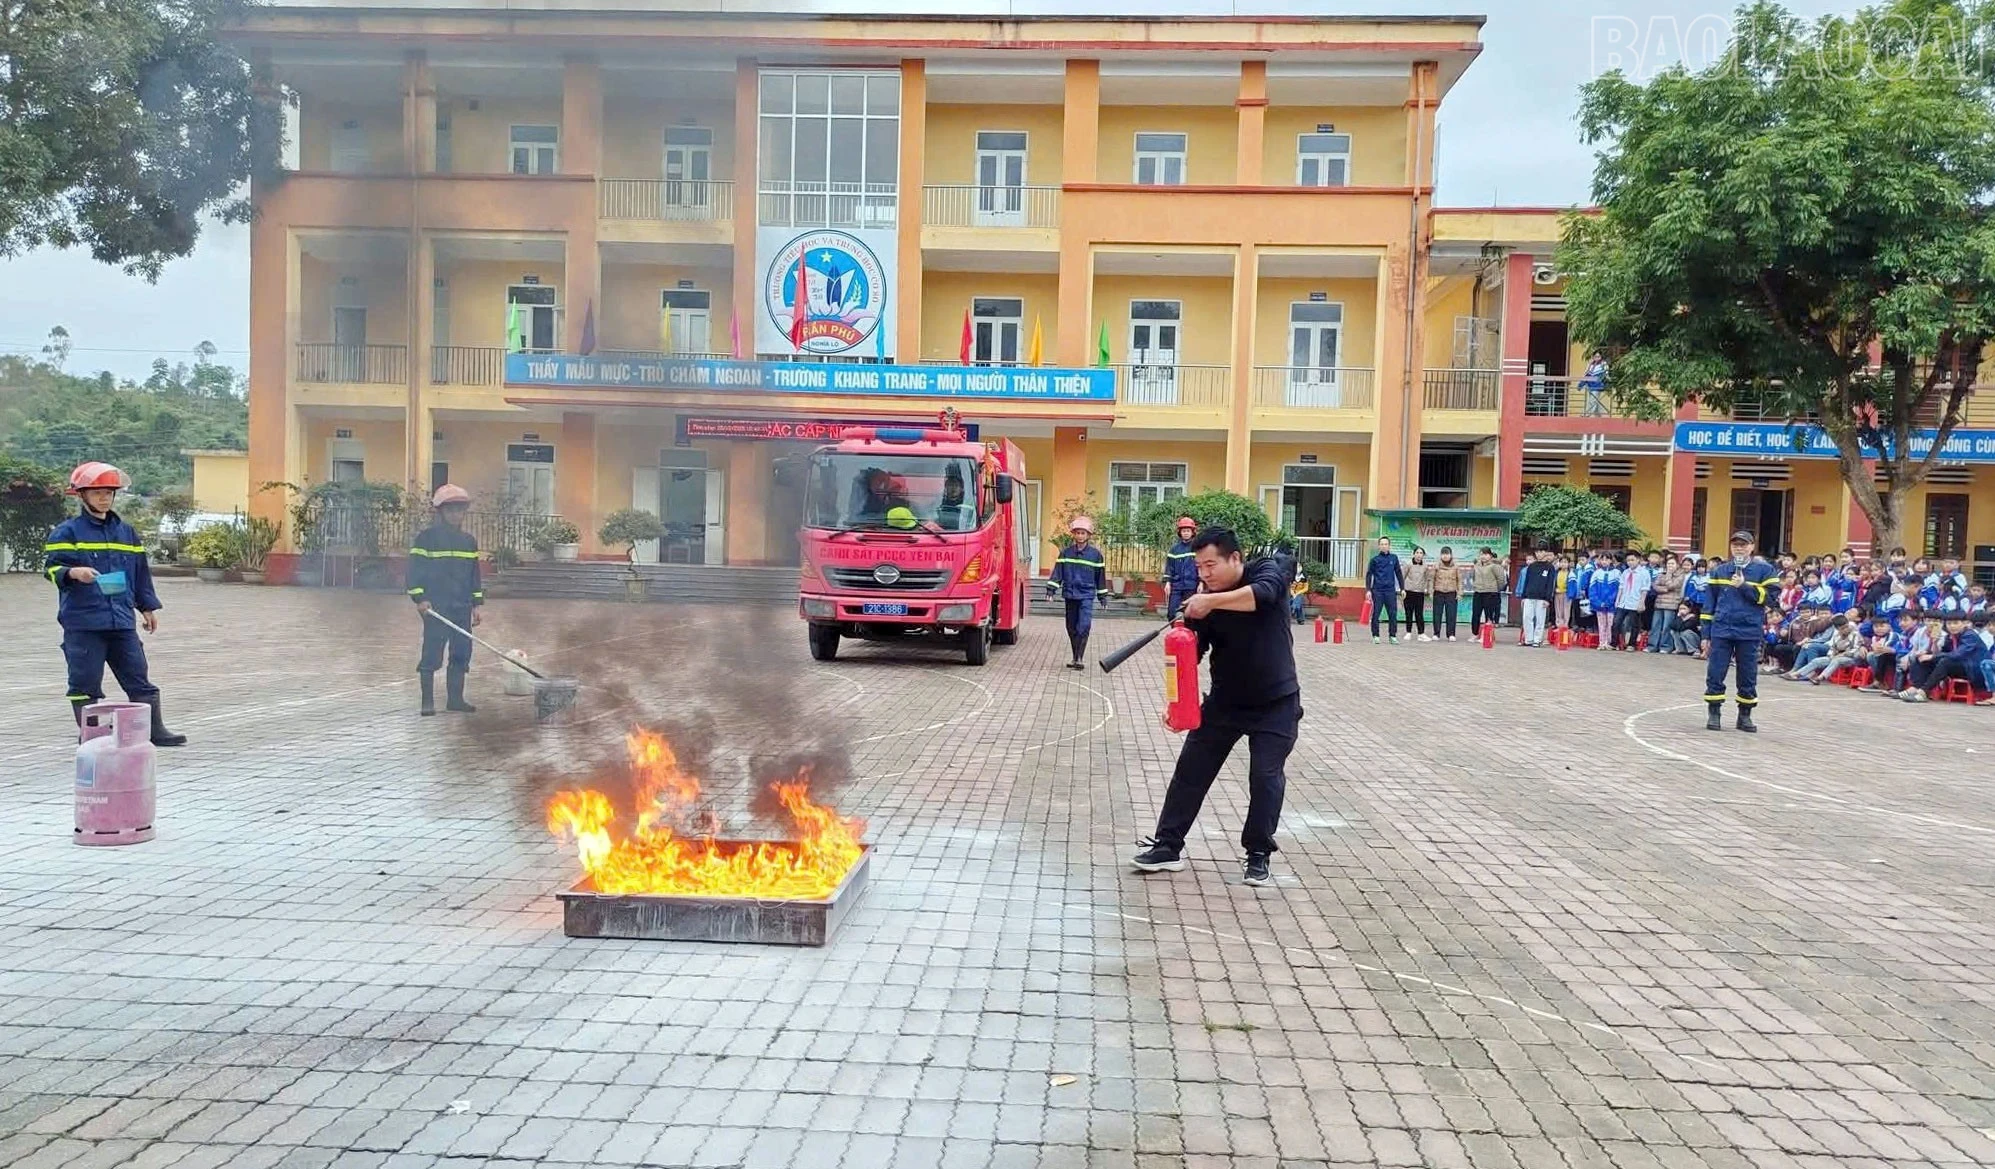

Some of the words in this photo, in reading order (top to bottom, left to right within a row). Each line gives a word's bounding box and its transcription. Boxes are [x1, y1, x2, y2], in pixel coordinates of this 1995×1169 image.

[527, 358, 560, 380] THẦY
[565, 358, 595, 381] MẪU
[601, 361, 631, 384] MỰC
[670, 364, 710, 384] CHĂM
[715, 367, 762, 385] NGOAN
[773, 366, 827, 388] TRƯỜNG
[834, 371, 879, 389] KHANG
[884, 372, 927, 390] TRANG
[937, 374, 962, 394] MỌI
[966, 370, 1007, 392] NGƯỜI
[1013, 373, 1047, 393] THÂN
[1053, 374, 1091, 397] THIỆN
[1688, 430, 1712, 447] HỌC
[1717, 426, 1734, 446] ĐỂ
[1736, 428, 1762, 448] BIẾT,
[1766, 433, 1790, 449] HỌC
[1940, 434, 1971, 453] ỐNG
